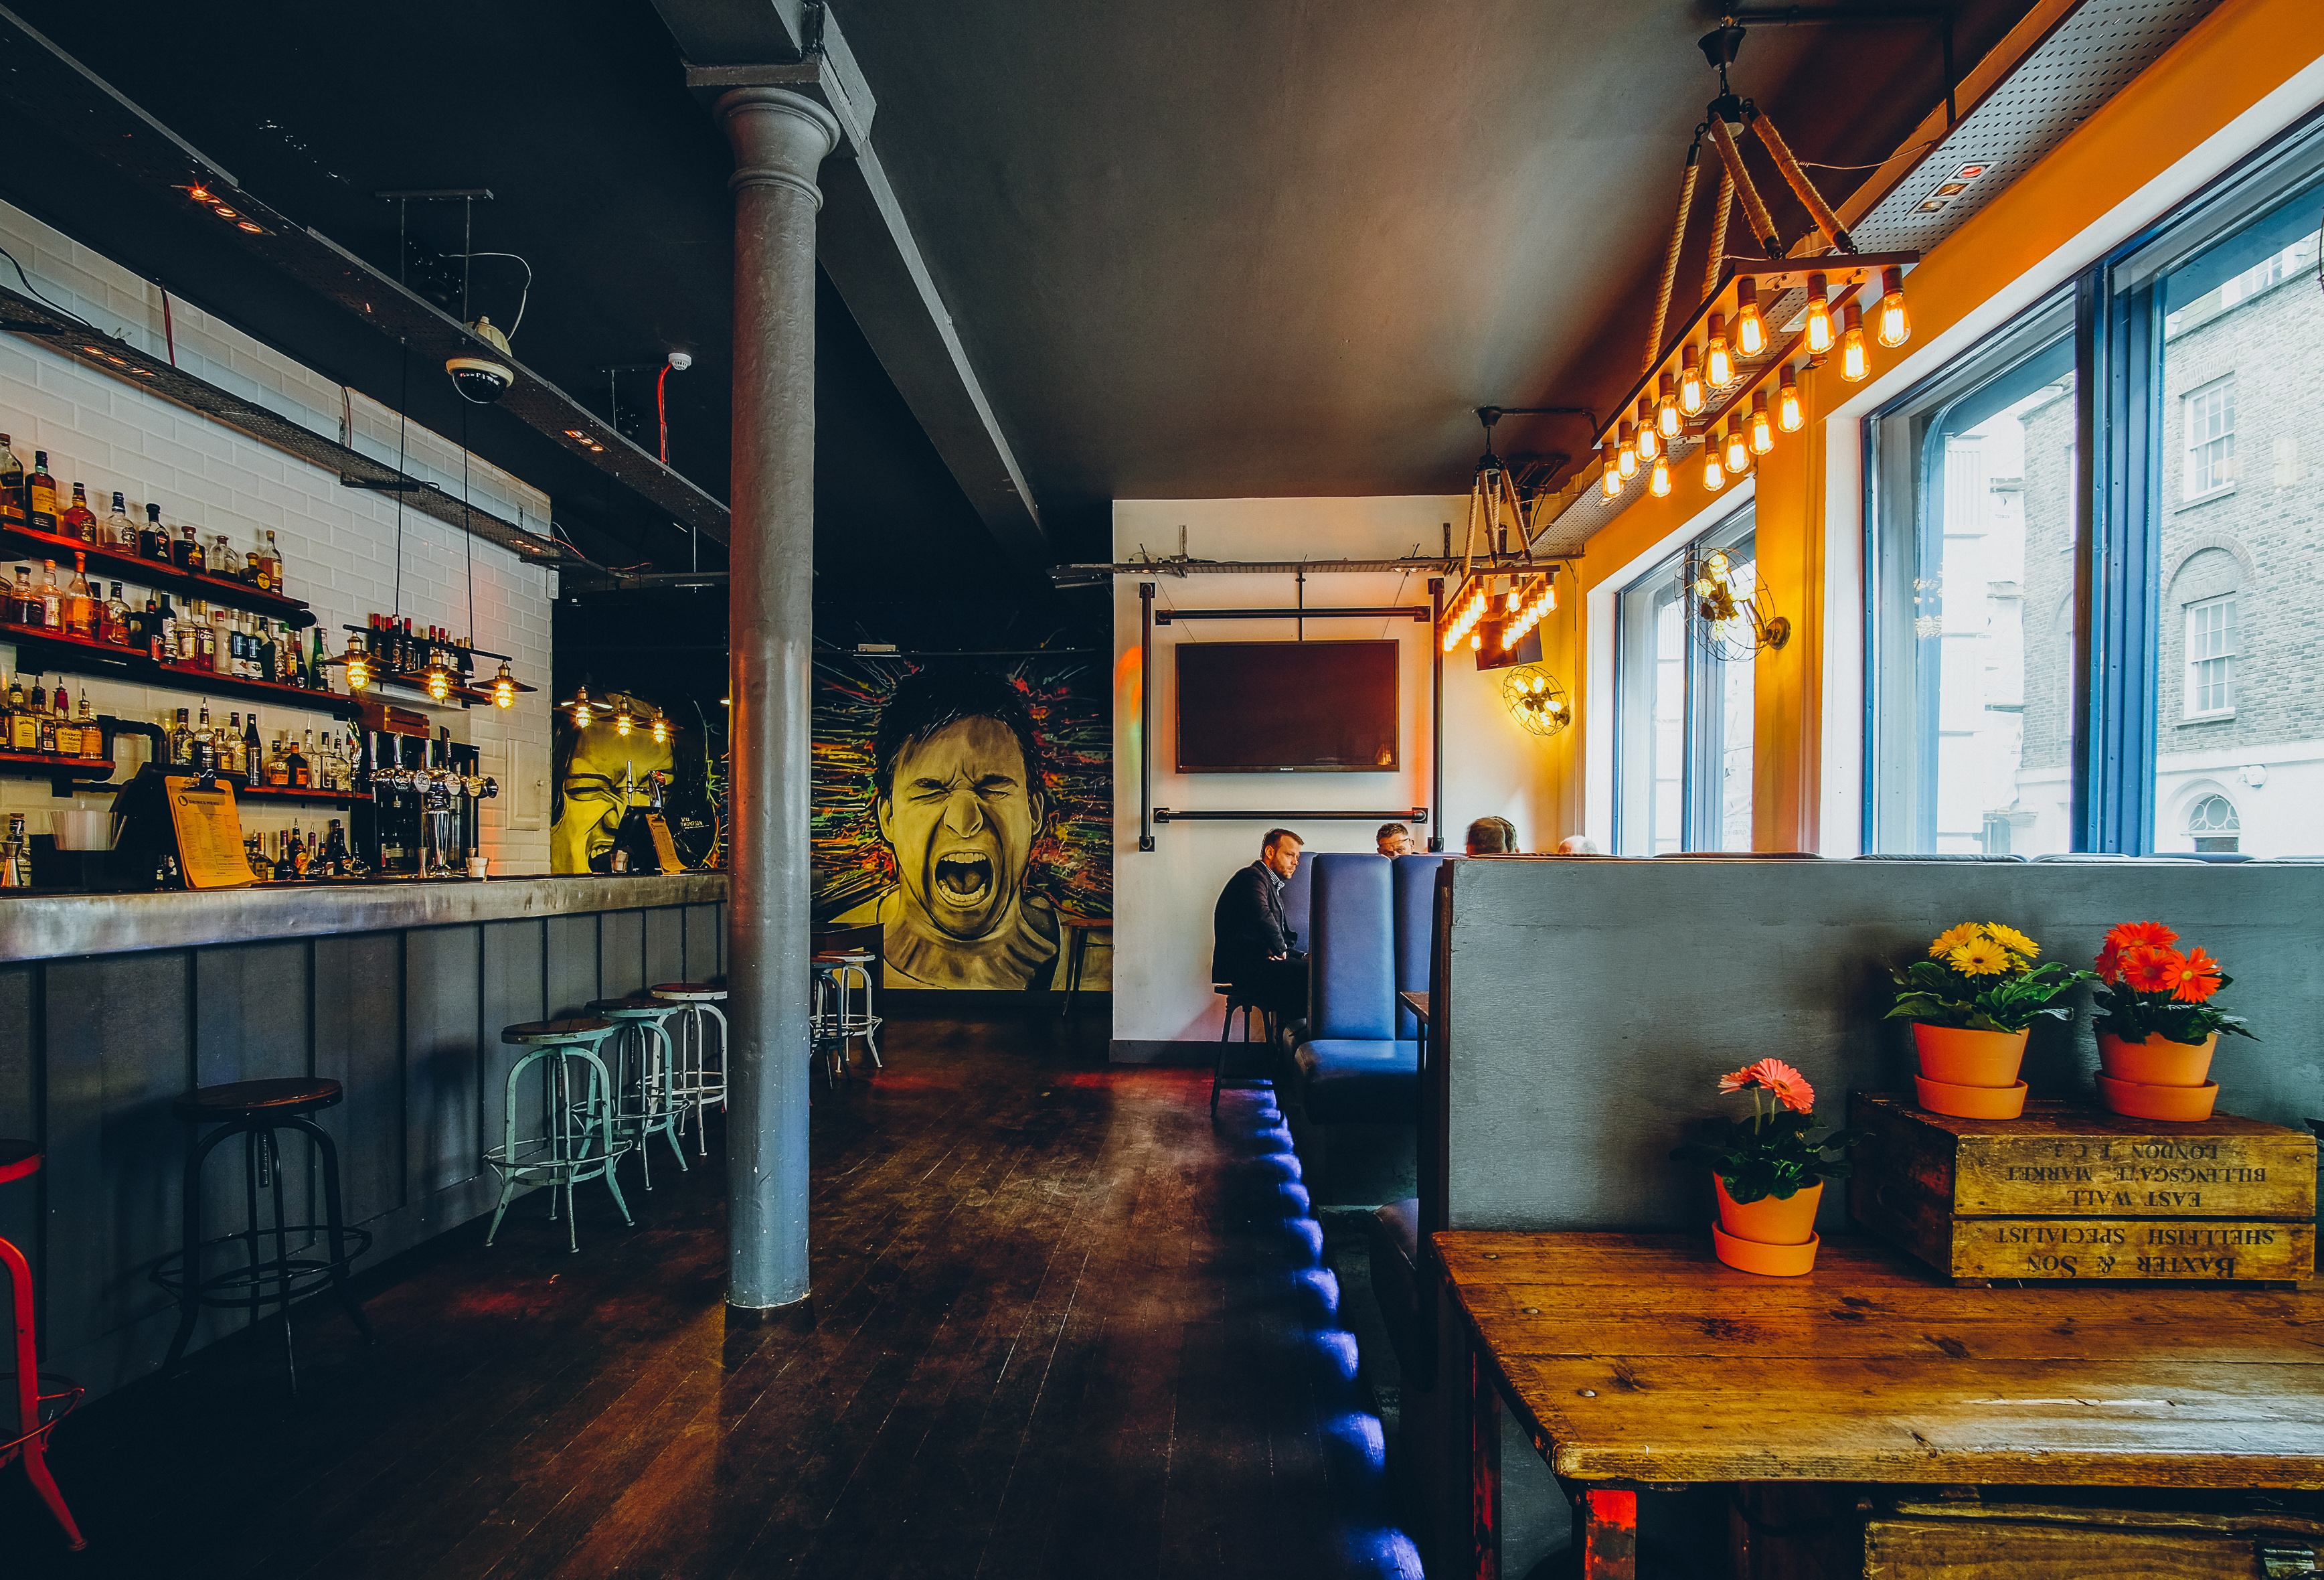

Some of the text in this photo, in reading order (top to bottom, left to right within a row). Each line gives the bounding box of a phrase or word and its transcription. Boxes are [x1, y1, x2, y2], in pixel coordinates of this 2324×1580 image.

[2132, 1144, 2218, 1159] LONDON
[2005, 1166, 2266, 1182] BILLINGSGATE MARKET
[2066, 1190, 2202, 1207] EAST WALL
[1994, 1227, 2275, 1245] SHELLFISH SPECIALIST
[2096, 1255, 2116, 1273] &
